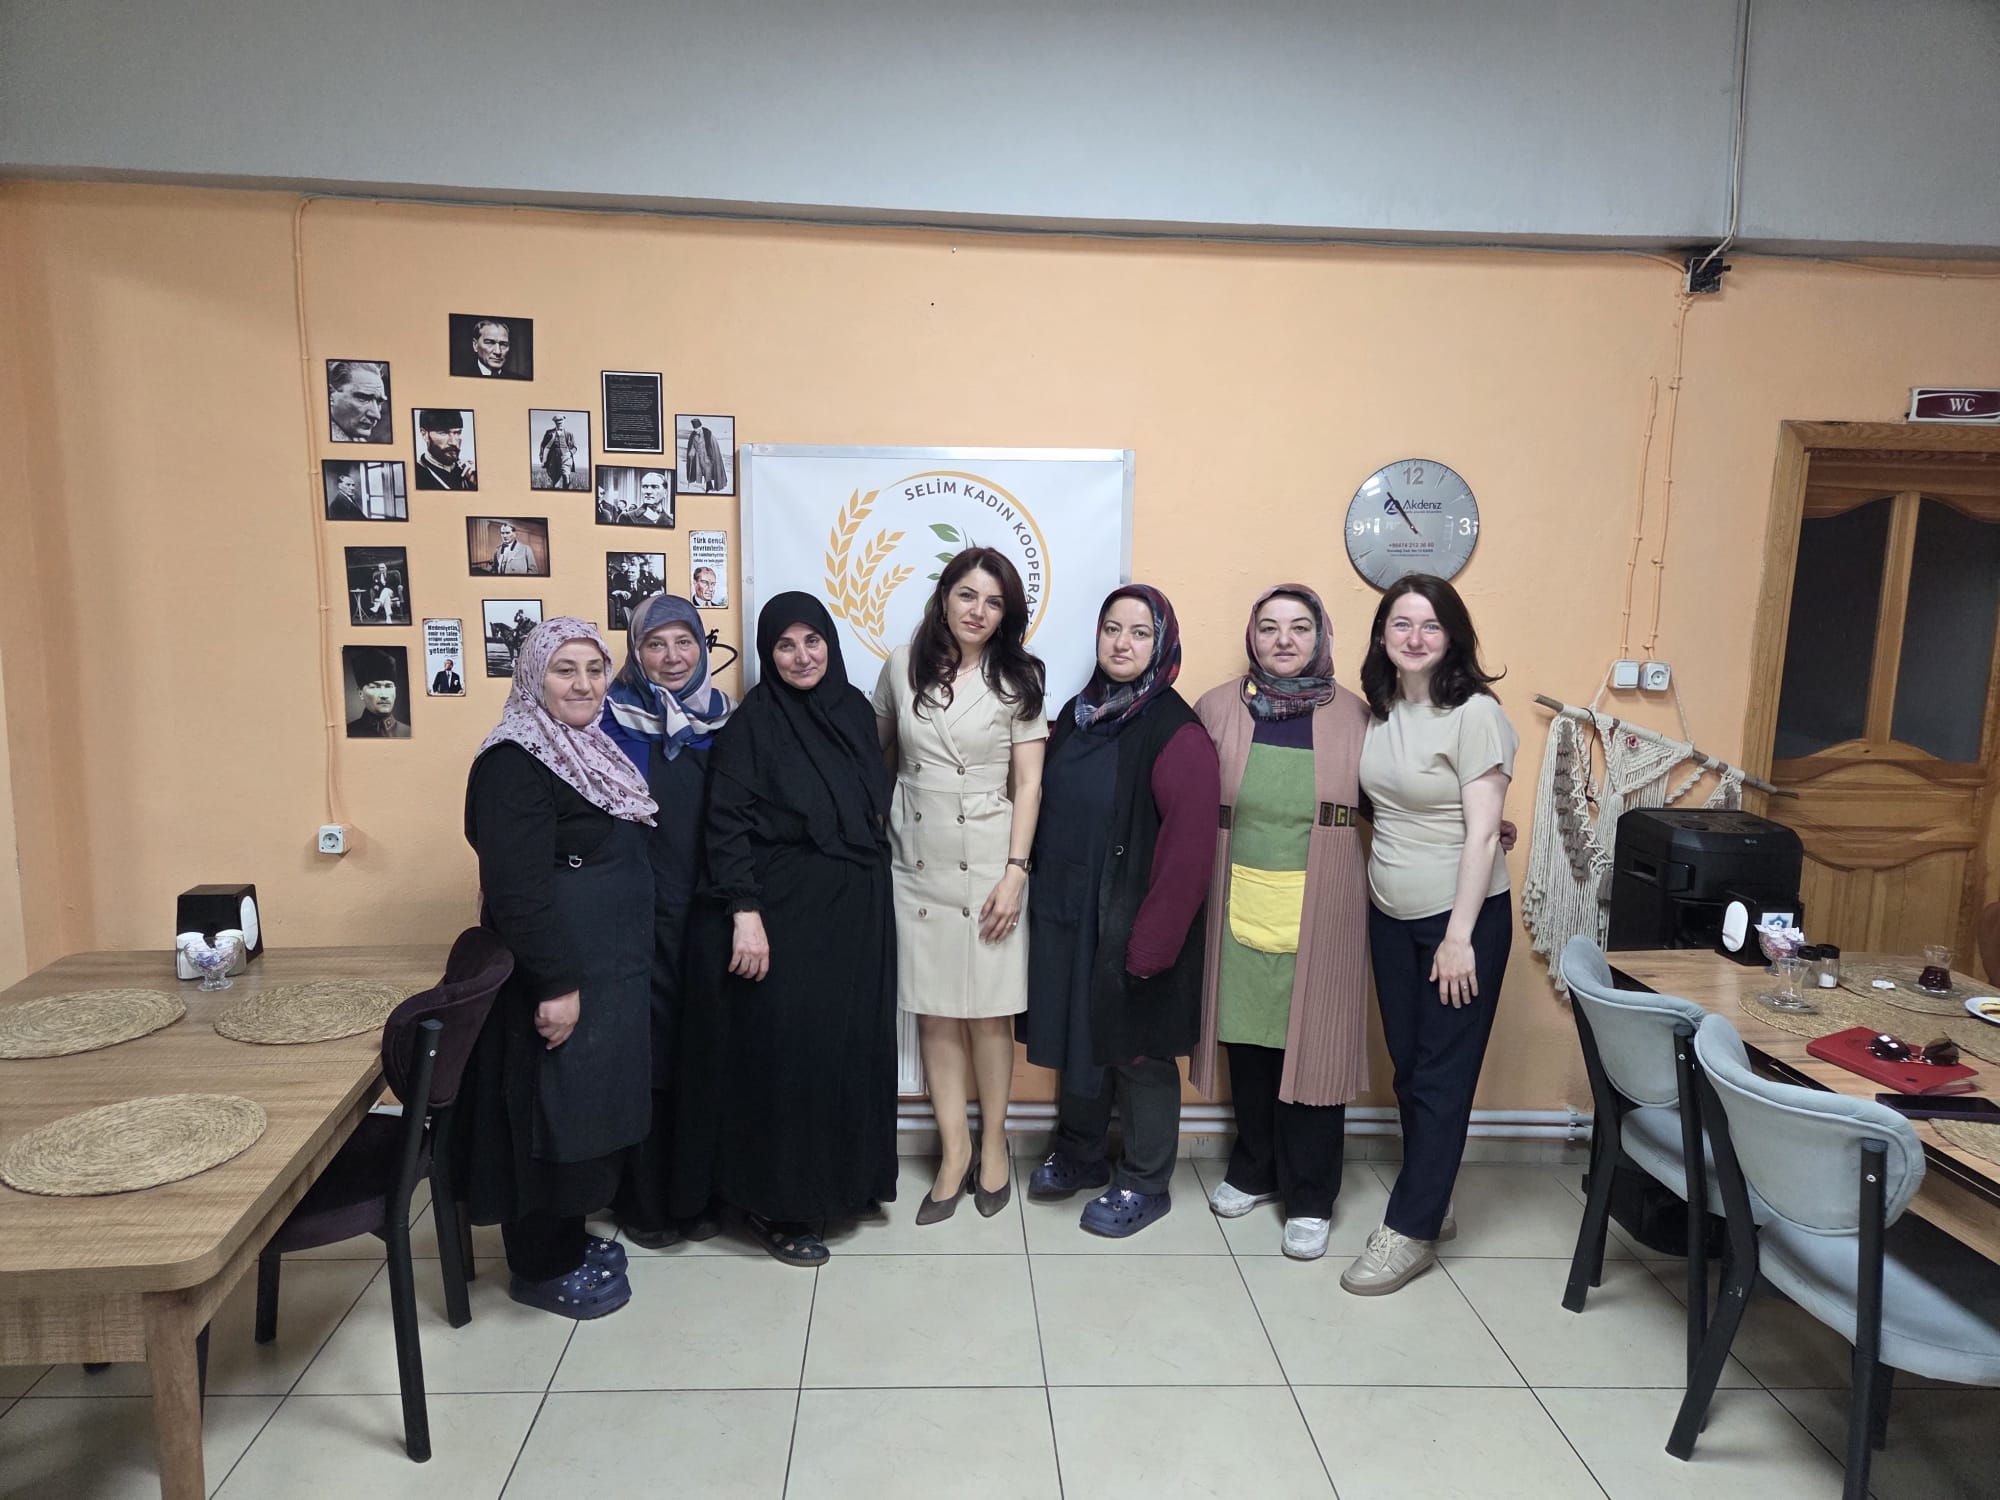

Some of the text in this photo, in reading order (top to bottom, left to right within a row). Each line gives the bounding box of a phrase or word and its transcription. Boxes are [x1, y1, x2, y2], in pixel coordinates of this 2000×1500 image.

[1949, 398, 1976, 412] WC
[1403, 467, 1424, 485] 12
[1458, 517, 1471, 536] 3
[904, 478, 1041, 624] SELİM KADIN KOOPERAT
